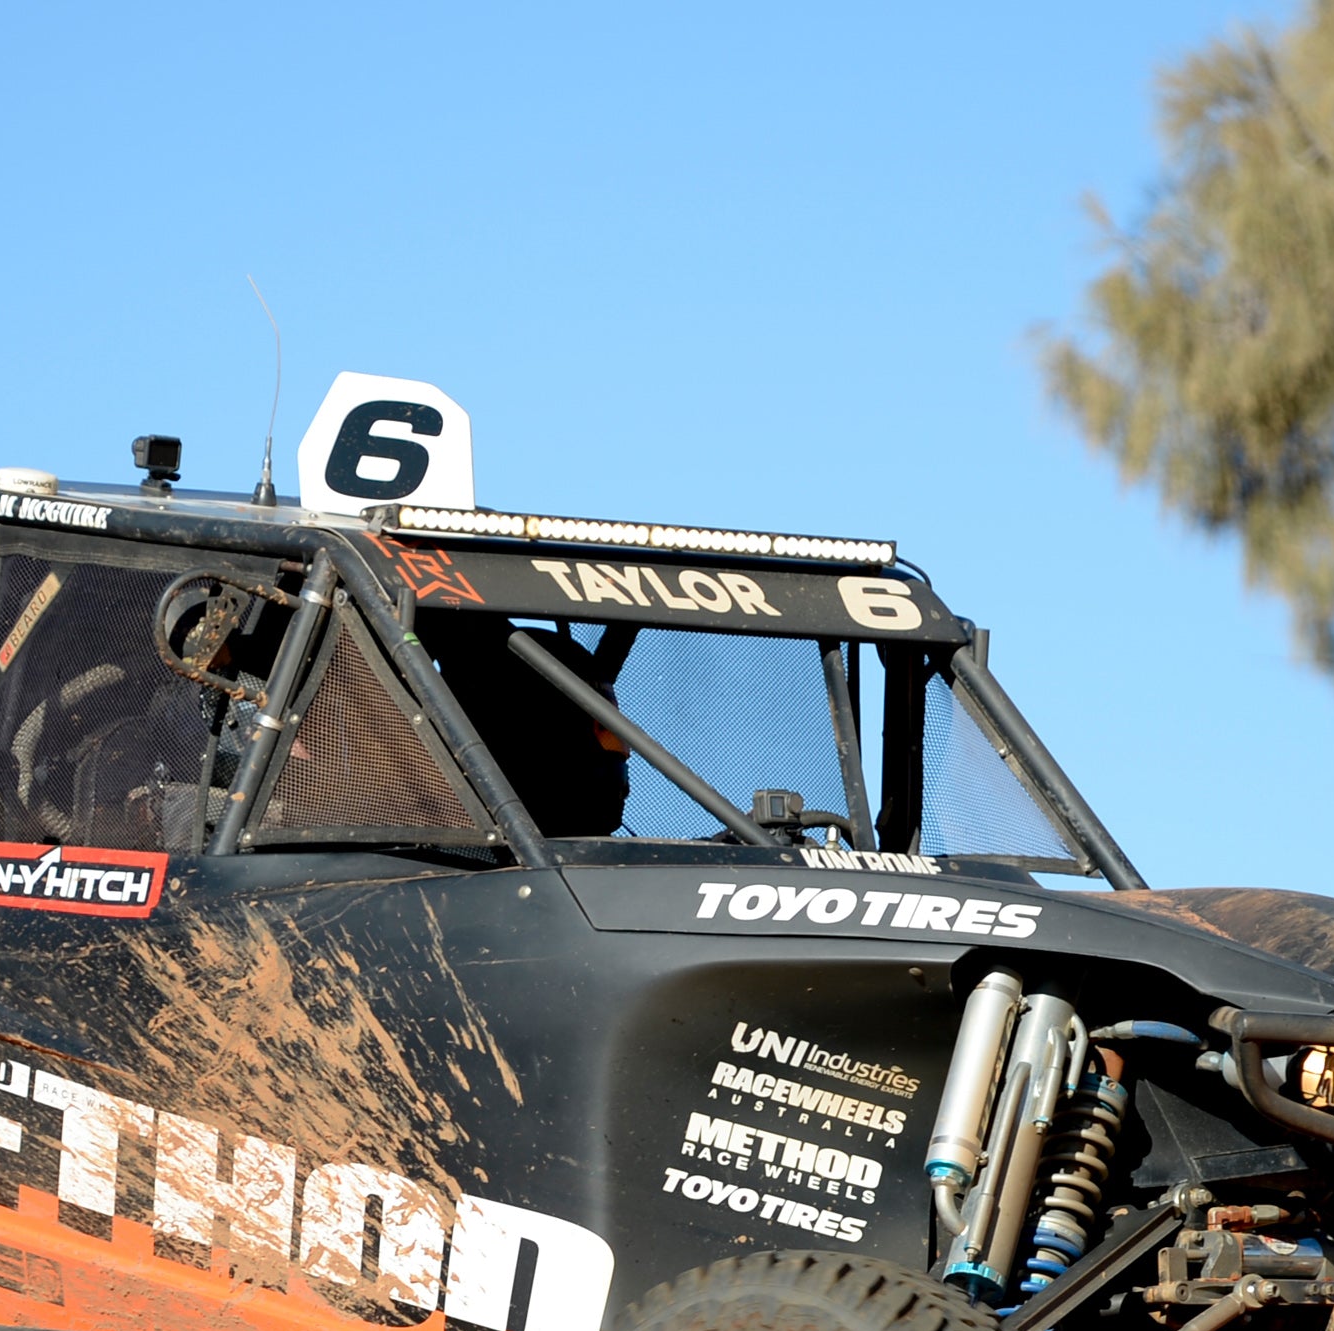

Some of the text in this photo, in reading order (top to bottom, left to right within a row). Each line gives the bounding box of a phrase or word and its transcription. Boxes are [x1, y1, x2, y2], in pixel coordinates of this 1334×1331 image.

[324, 399, 443, 499] 6
[13, 478, 53, 489] LOWRANCE
[9, 590, 47, 647] BEARD
[531, 559, 783, 617] TAYLOR
[836, 576, 923, 631] 6
[731, 1021, 921, 1093] UNI Industries
[803, 1062, 915, 1100] RENEWABLE ENERGY EXPERTS
[707, 1087, 896, 1150] AUSTRALIA
[712, 1061, 907, 1136] RACEWHEELS
[680, 1142, 876, 1206] RACE WHEELS
[685, 1111, 883, 1191] METHOD
